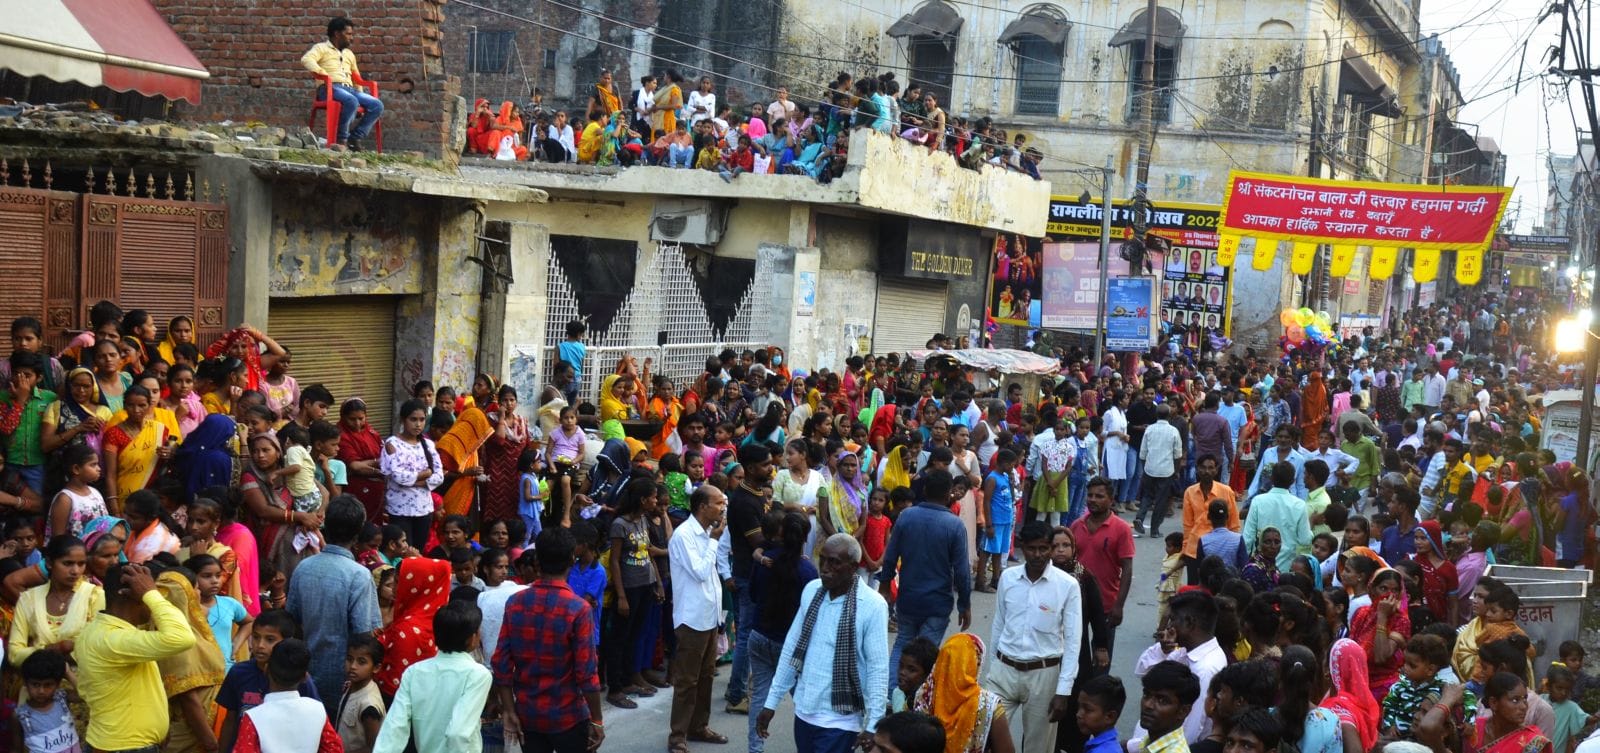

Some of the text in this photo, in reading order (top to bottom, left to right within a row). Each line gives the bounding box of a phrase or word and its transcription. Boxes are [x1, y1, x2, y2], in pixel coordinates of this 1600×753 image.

[1238, 182, 1488, 216] श्री संकटमोचन बाला जी दरबार हनुमान गढ़ी
[1242, 213, 1284, 228] आपका
[1286, 216, 1320, 232] हार्दिक
[1325, 221, 1369, 235] स्वागत
[1375, 225, 1412, 238] करता
[1420, 225, 1434, 240] है
[911, 251, 973, 276] THE GOLDEN DINER
[44, 729, 73, 750] baby
